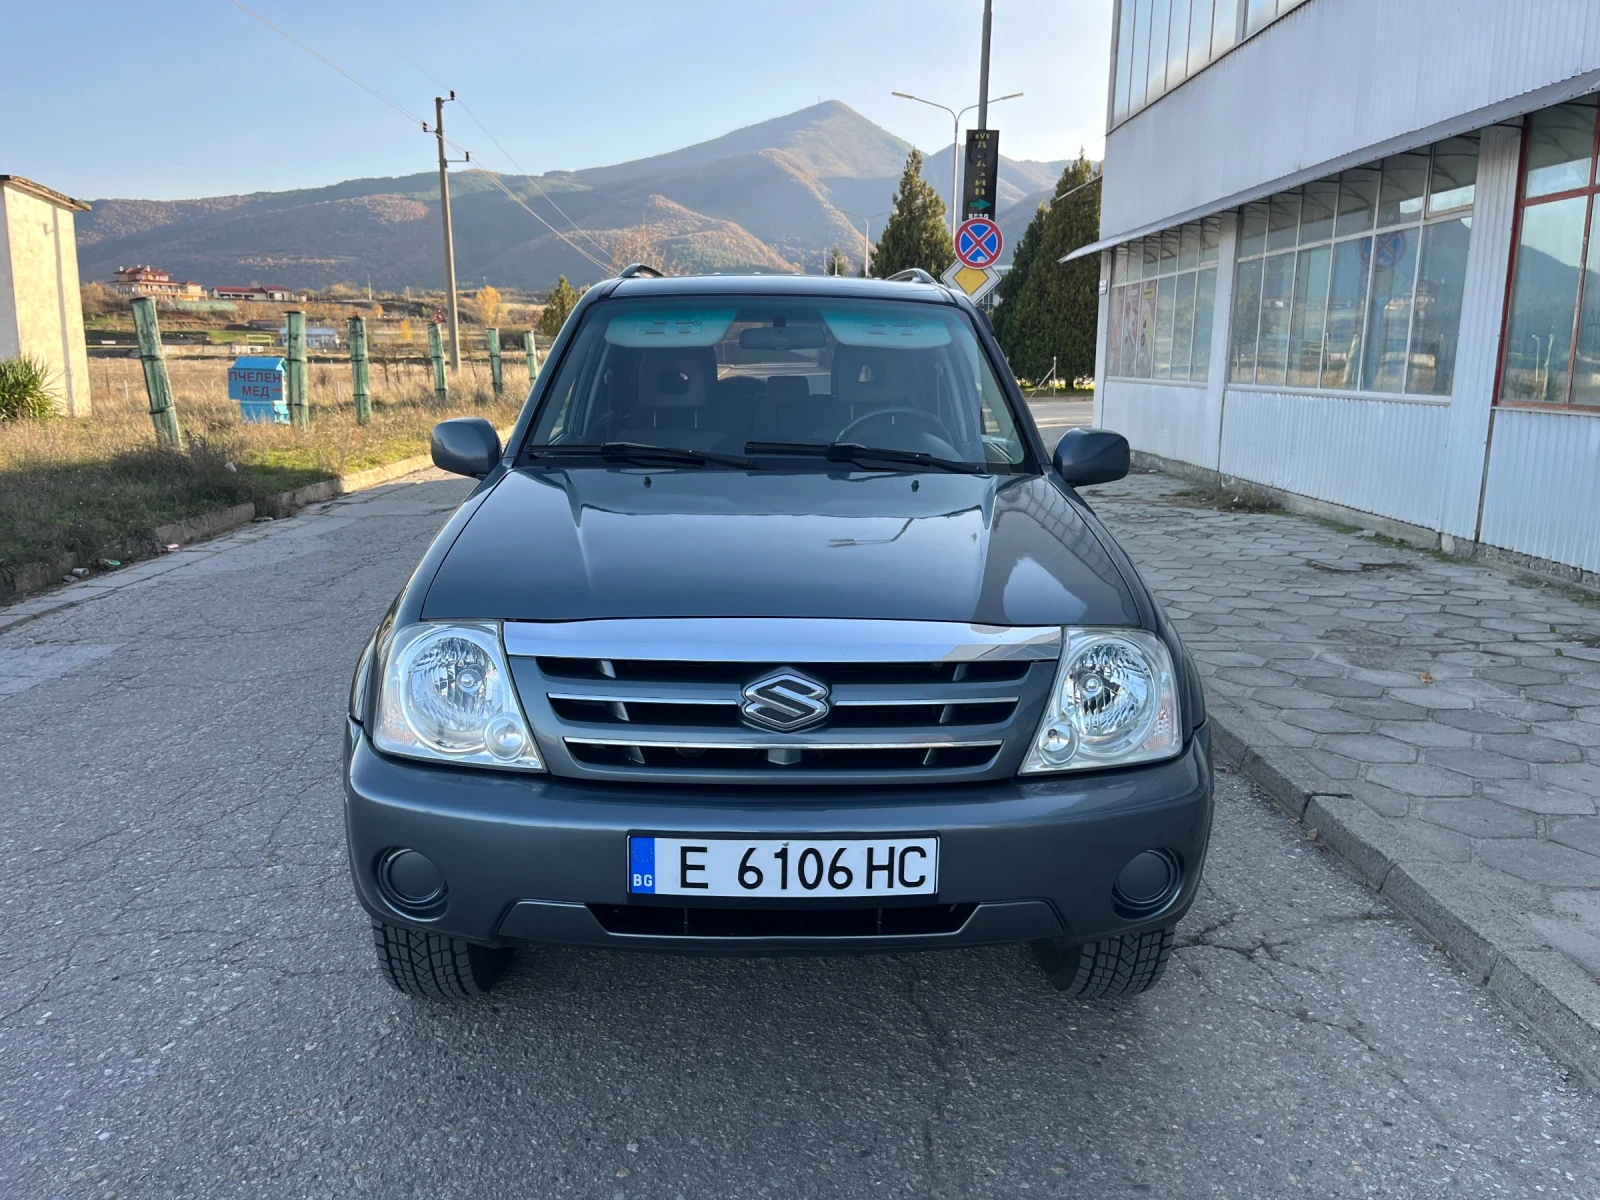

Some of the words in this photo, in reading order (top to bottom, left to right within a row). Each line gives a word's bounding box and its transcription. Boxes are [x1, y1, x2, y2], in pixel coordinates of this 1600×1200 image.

[229, 371, 281, 383] ПЧЕЛЕН
[242, 386, 270, 398] МЕД
[680, 846, 709, 889] E
[737, 847, 853, 890] 6106
[865, 846, 927, 889] HC
[633, 875, 653, 887] BG
